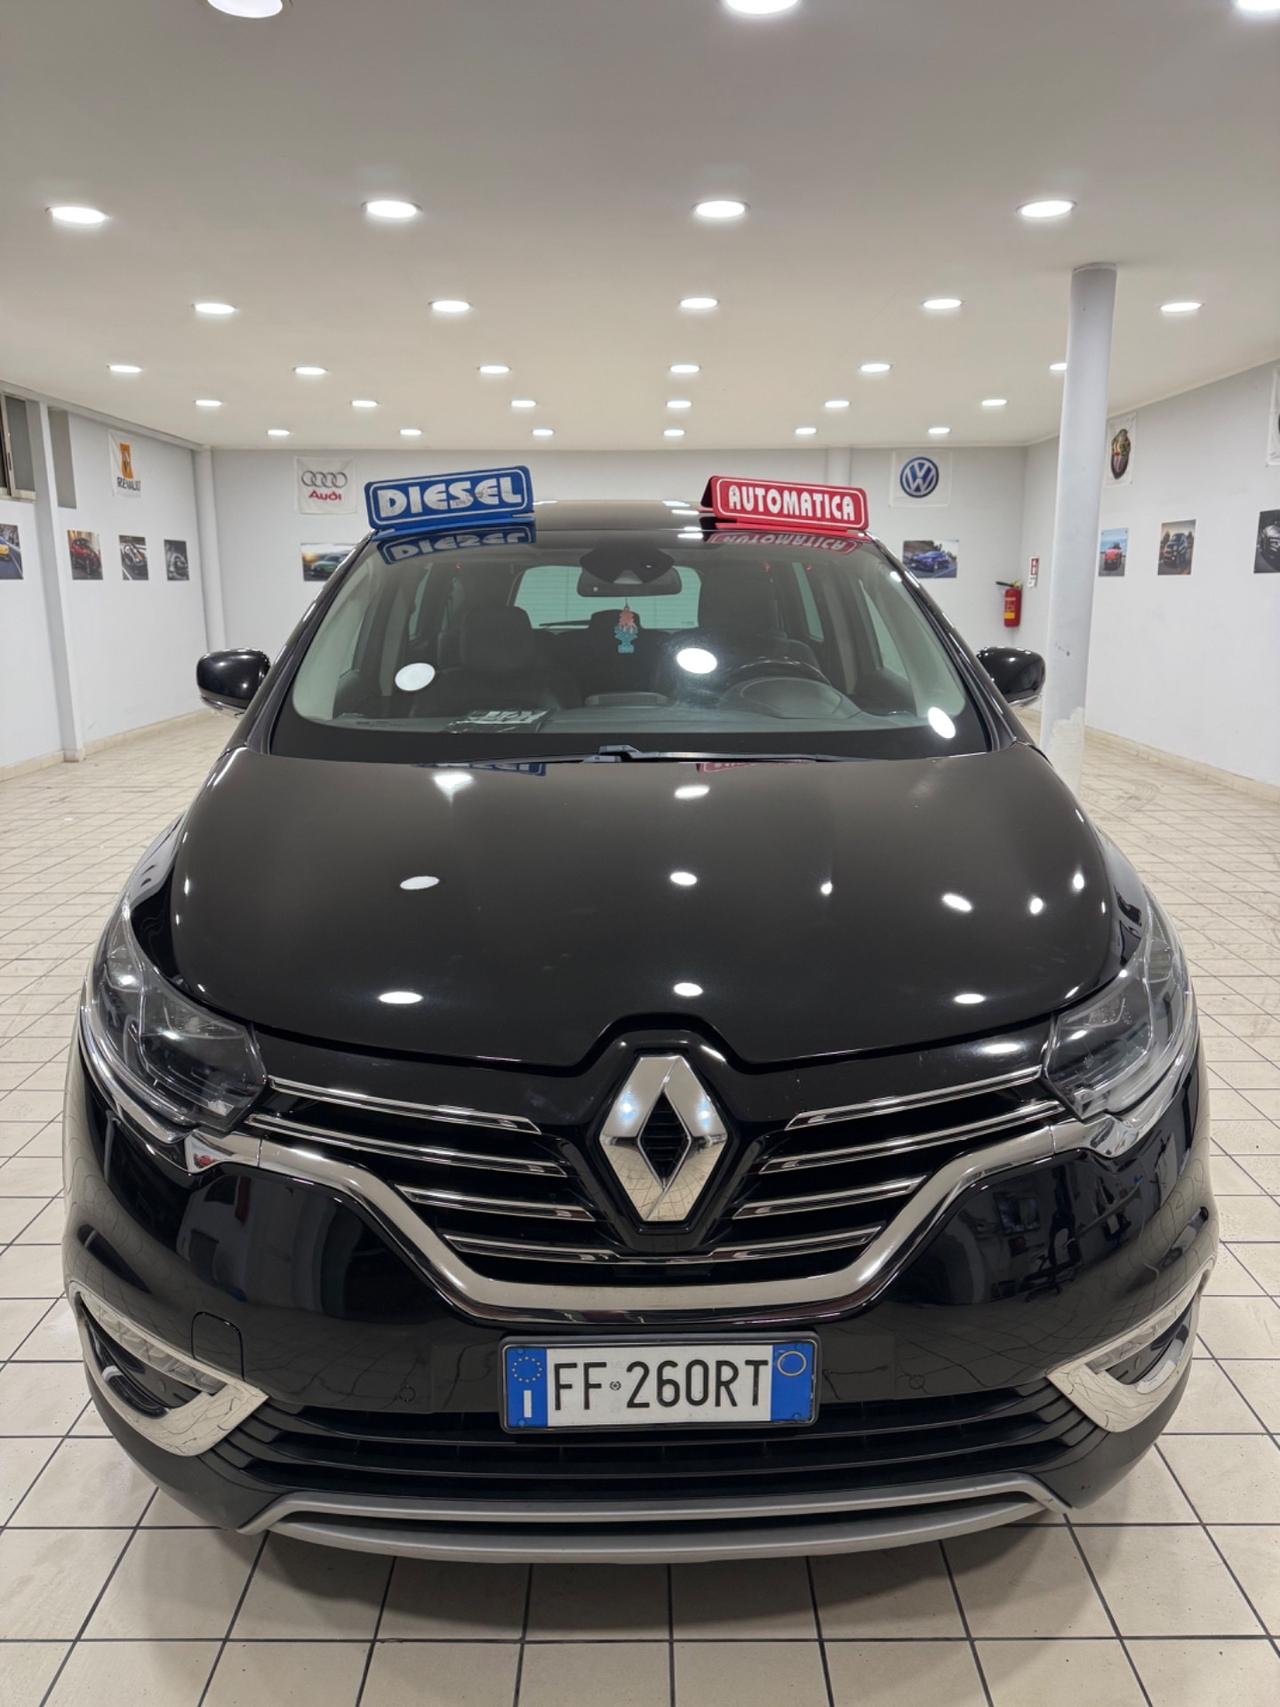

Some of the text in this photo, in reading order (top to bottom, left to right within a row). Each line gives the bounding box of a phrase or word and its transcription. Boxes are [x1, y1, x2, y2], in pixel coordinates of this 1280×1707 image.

[308, 490, 342, 501] Audi
[377, 477, 522, 518] DIESEL
[728, 485, 855, 521] AUTOMATICA
[554, 1361, 607, 1411] FF
[626, 1359, 769, 1408] 260RT
